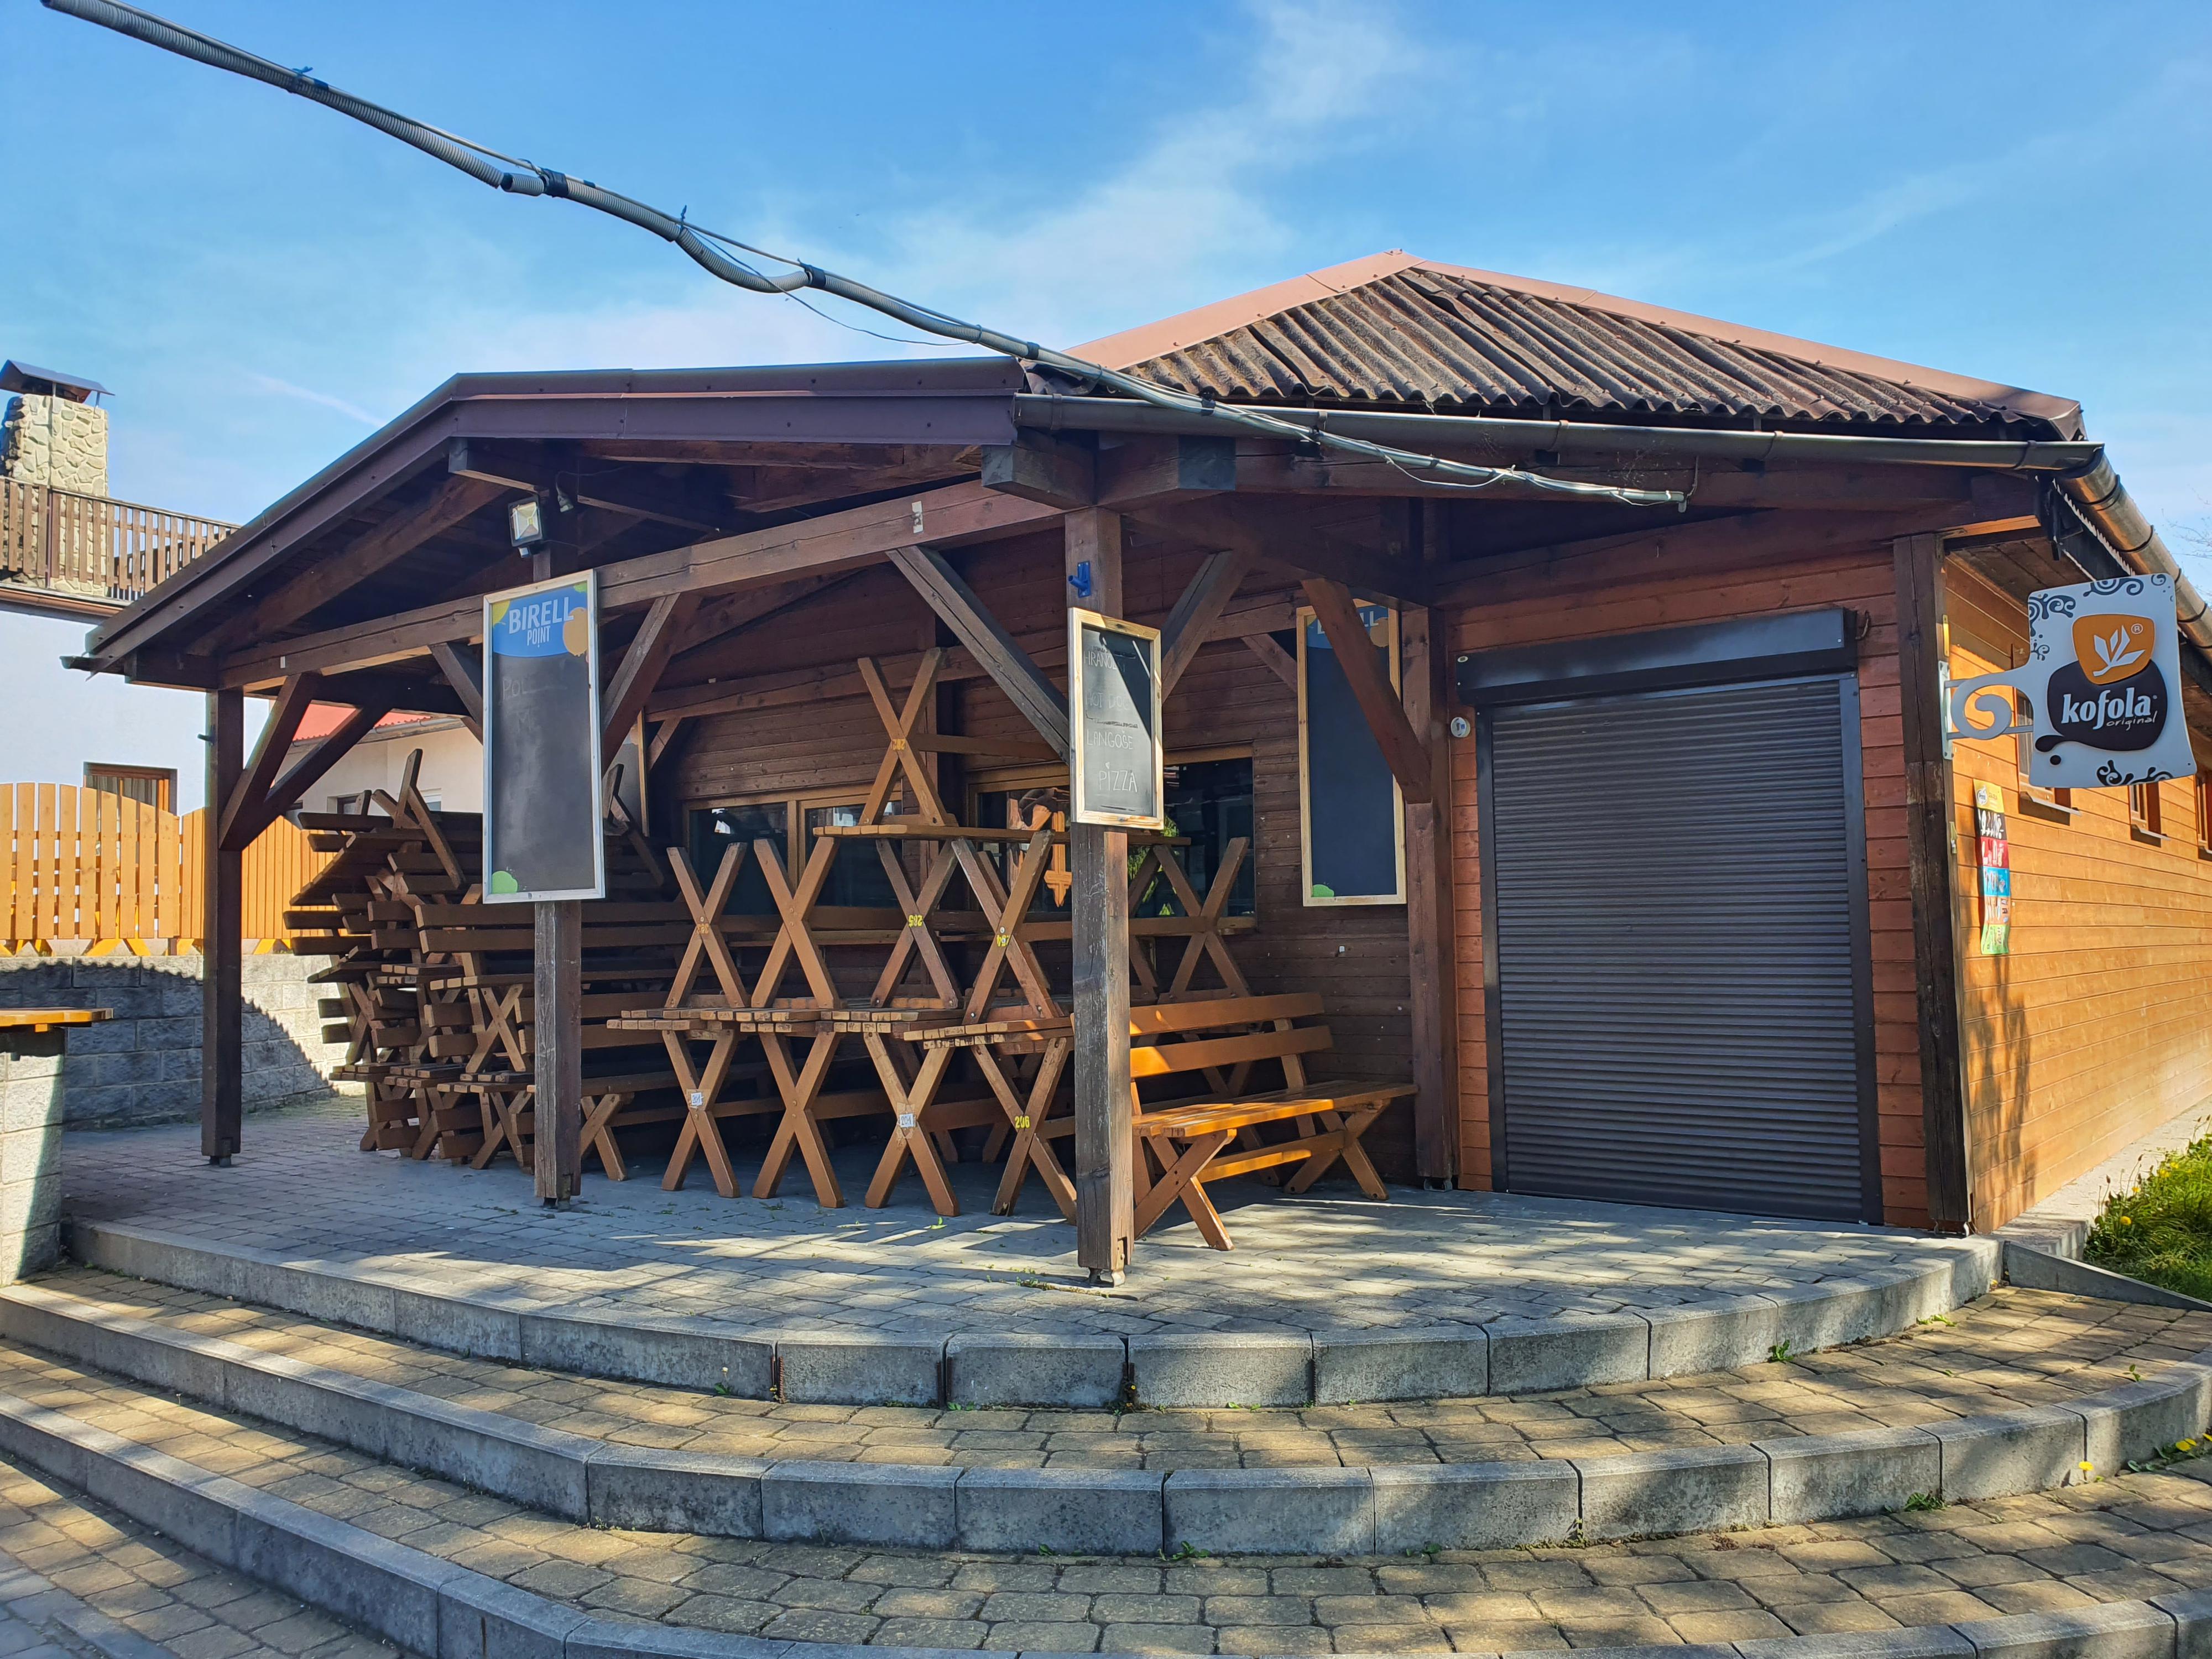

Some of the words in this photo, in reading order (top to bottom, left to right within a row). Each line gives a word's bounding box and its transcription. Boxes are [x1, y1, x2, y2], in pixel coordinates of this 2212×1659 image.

[509, 596, 575, 635] BIRELL
[526, 625, 551, 648] POINT
[2061, 687, 2152, 730] kofola
[2106, 710, 2158, 731] original
[1086, 729, 1133, 750] LANGOŠE
[1098, 761, 1138, 792] PIZZA
[908, 914, 923, 928] 205
[1014, 1115, 1030, 1128] 206
